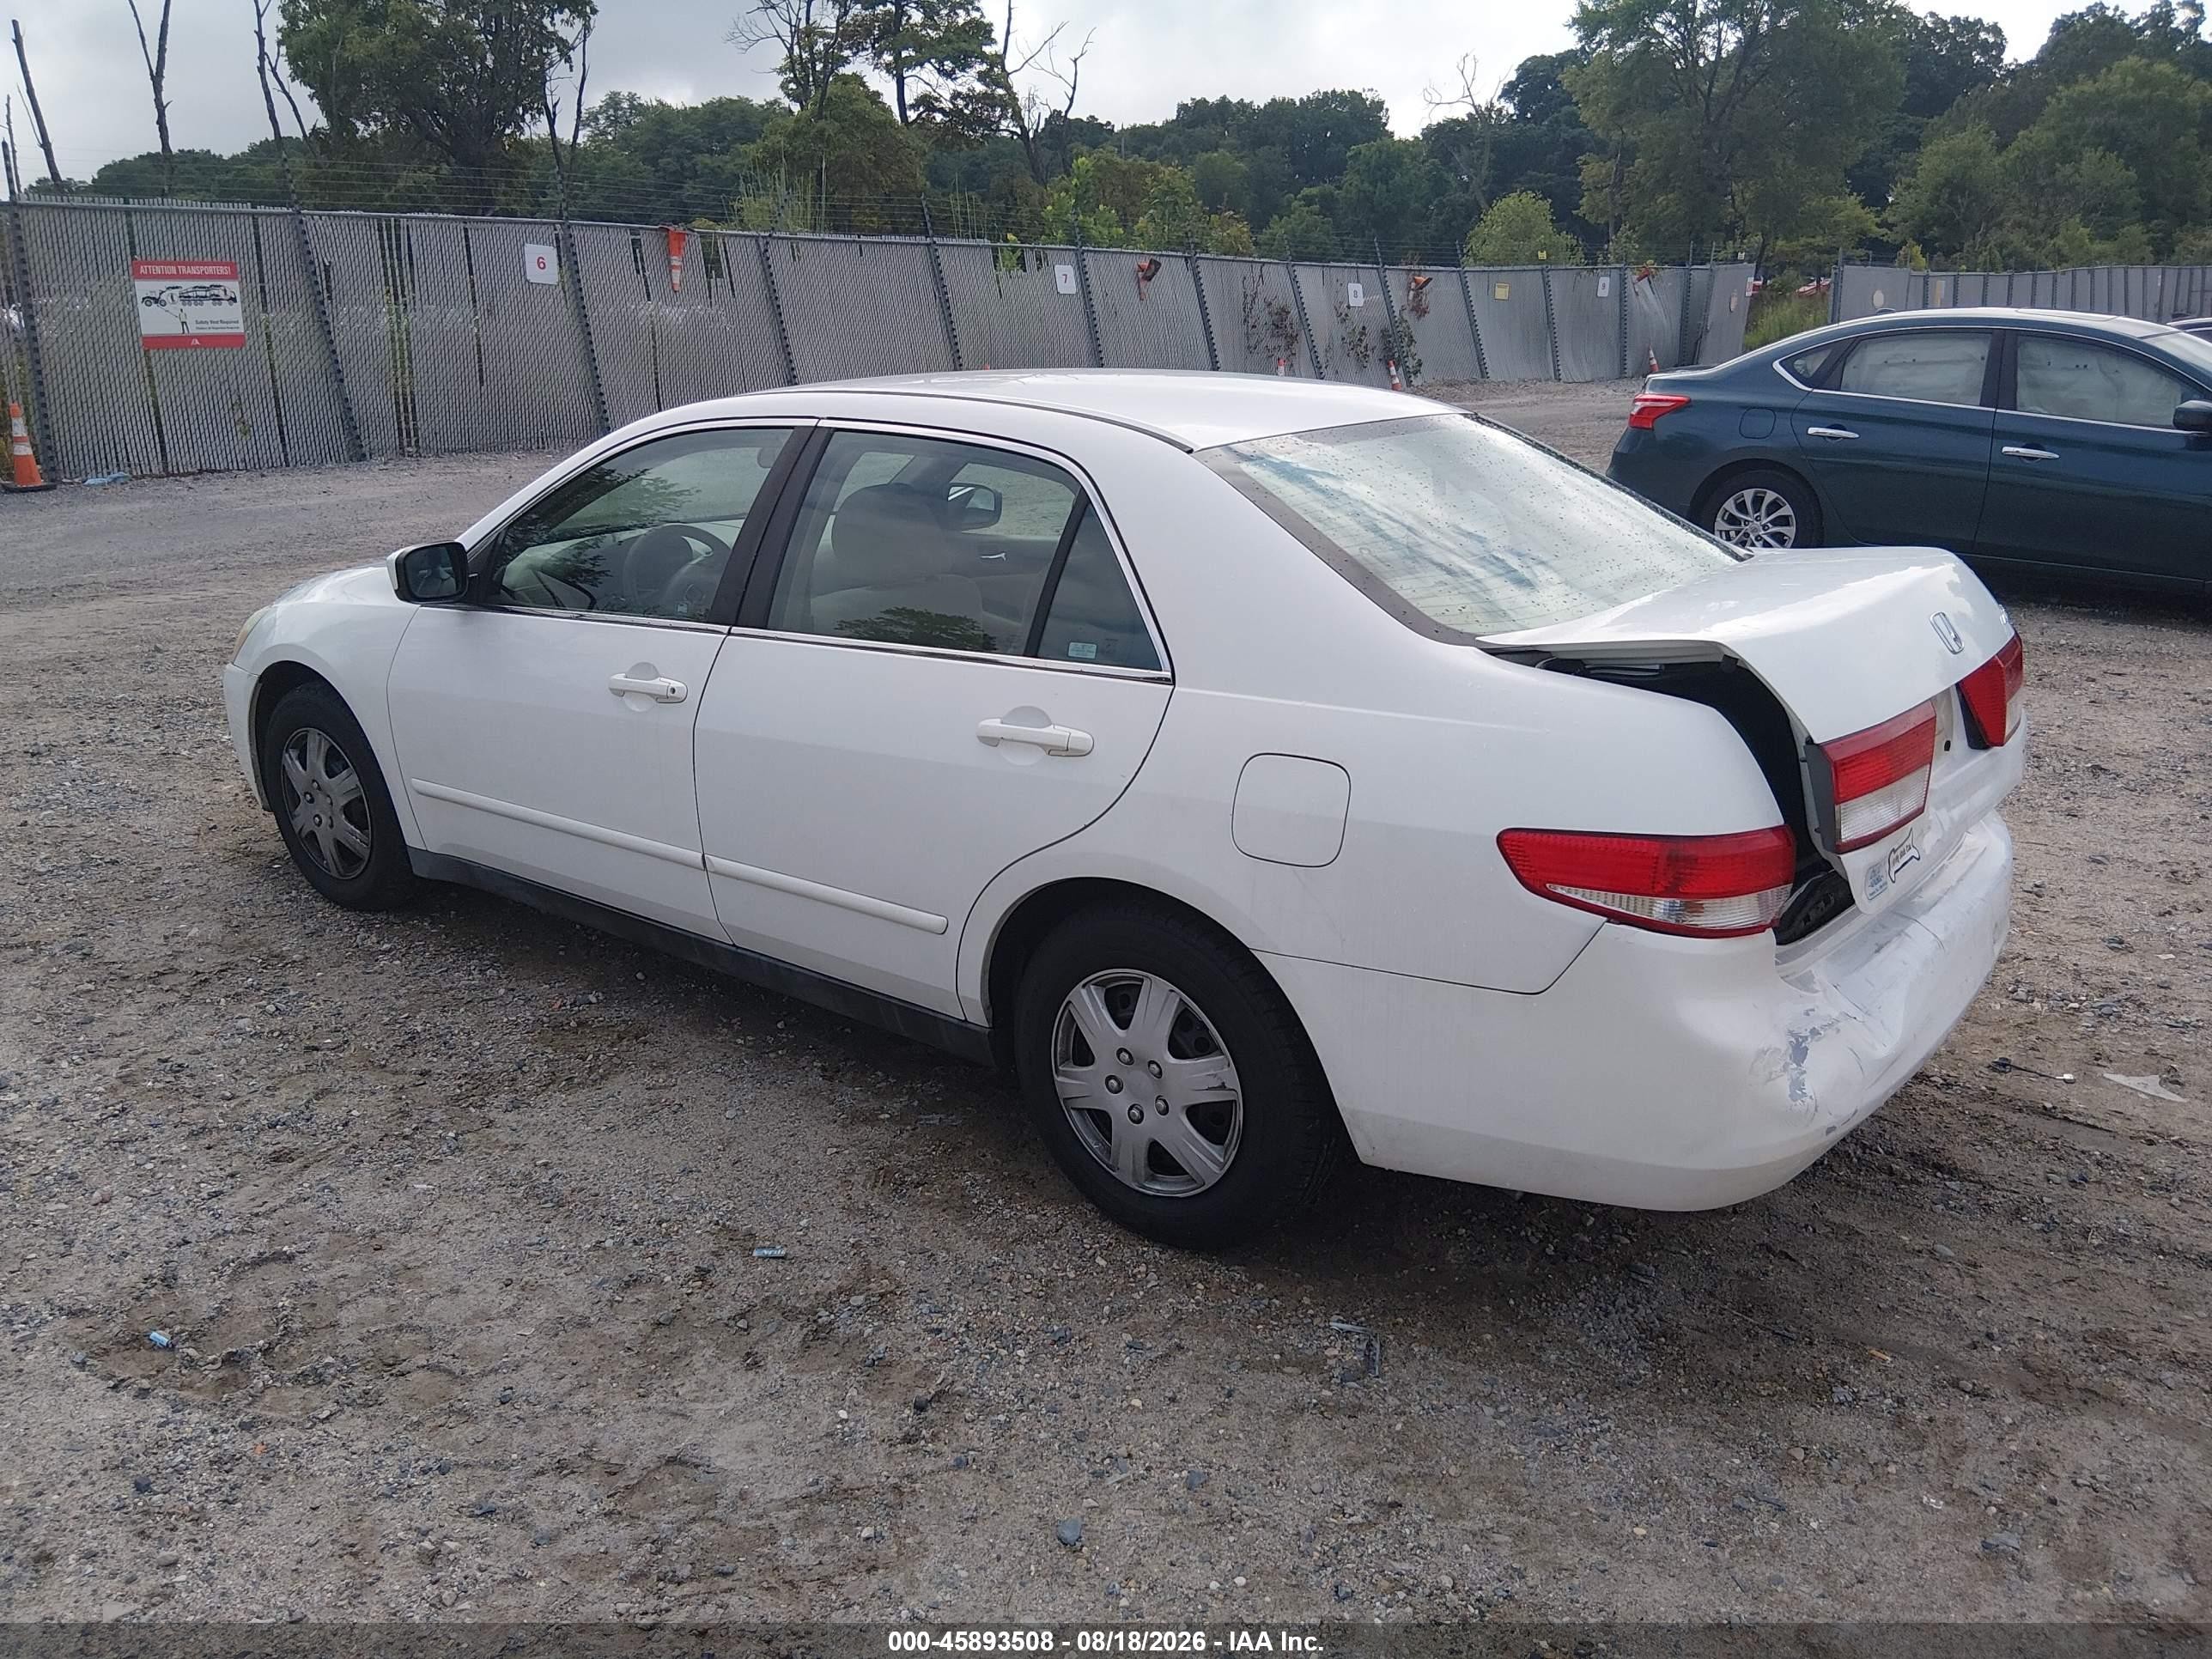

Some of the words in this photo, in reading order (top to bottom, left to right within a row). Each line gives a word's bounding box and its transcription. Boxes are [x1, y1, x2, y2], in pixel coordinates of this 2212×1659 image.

[537, 256, 546, 270] 6
[140, 264, 176, 275] ATTENTION
[177, 265, 231, 275] TRANSPORTERS!
[1061, 273, 1068, 284] 7
